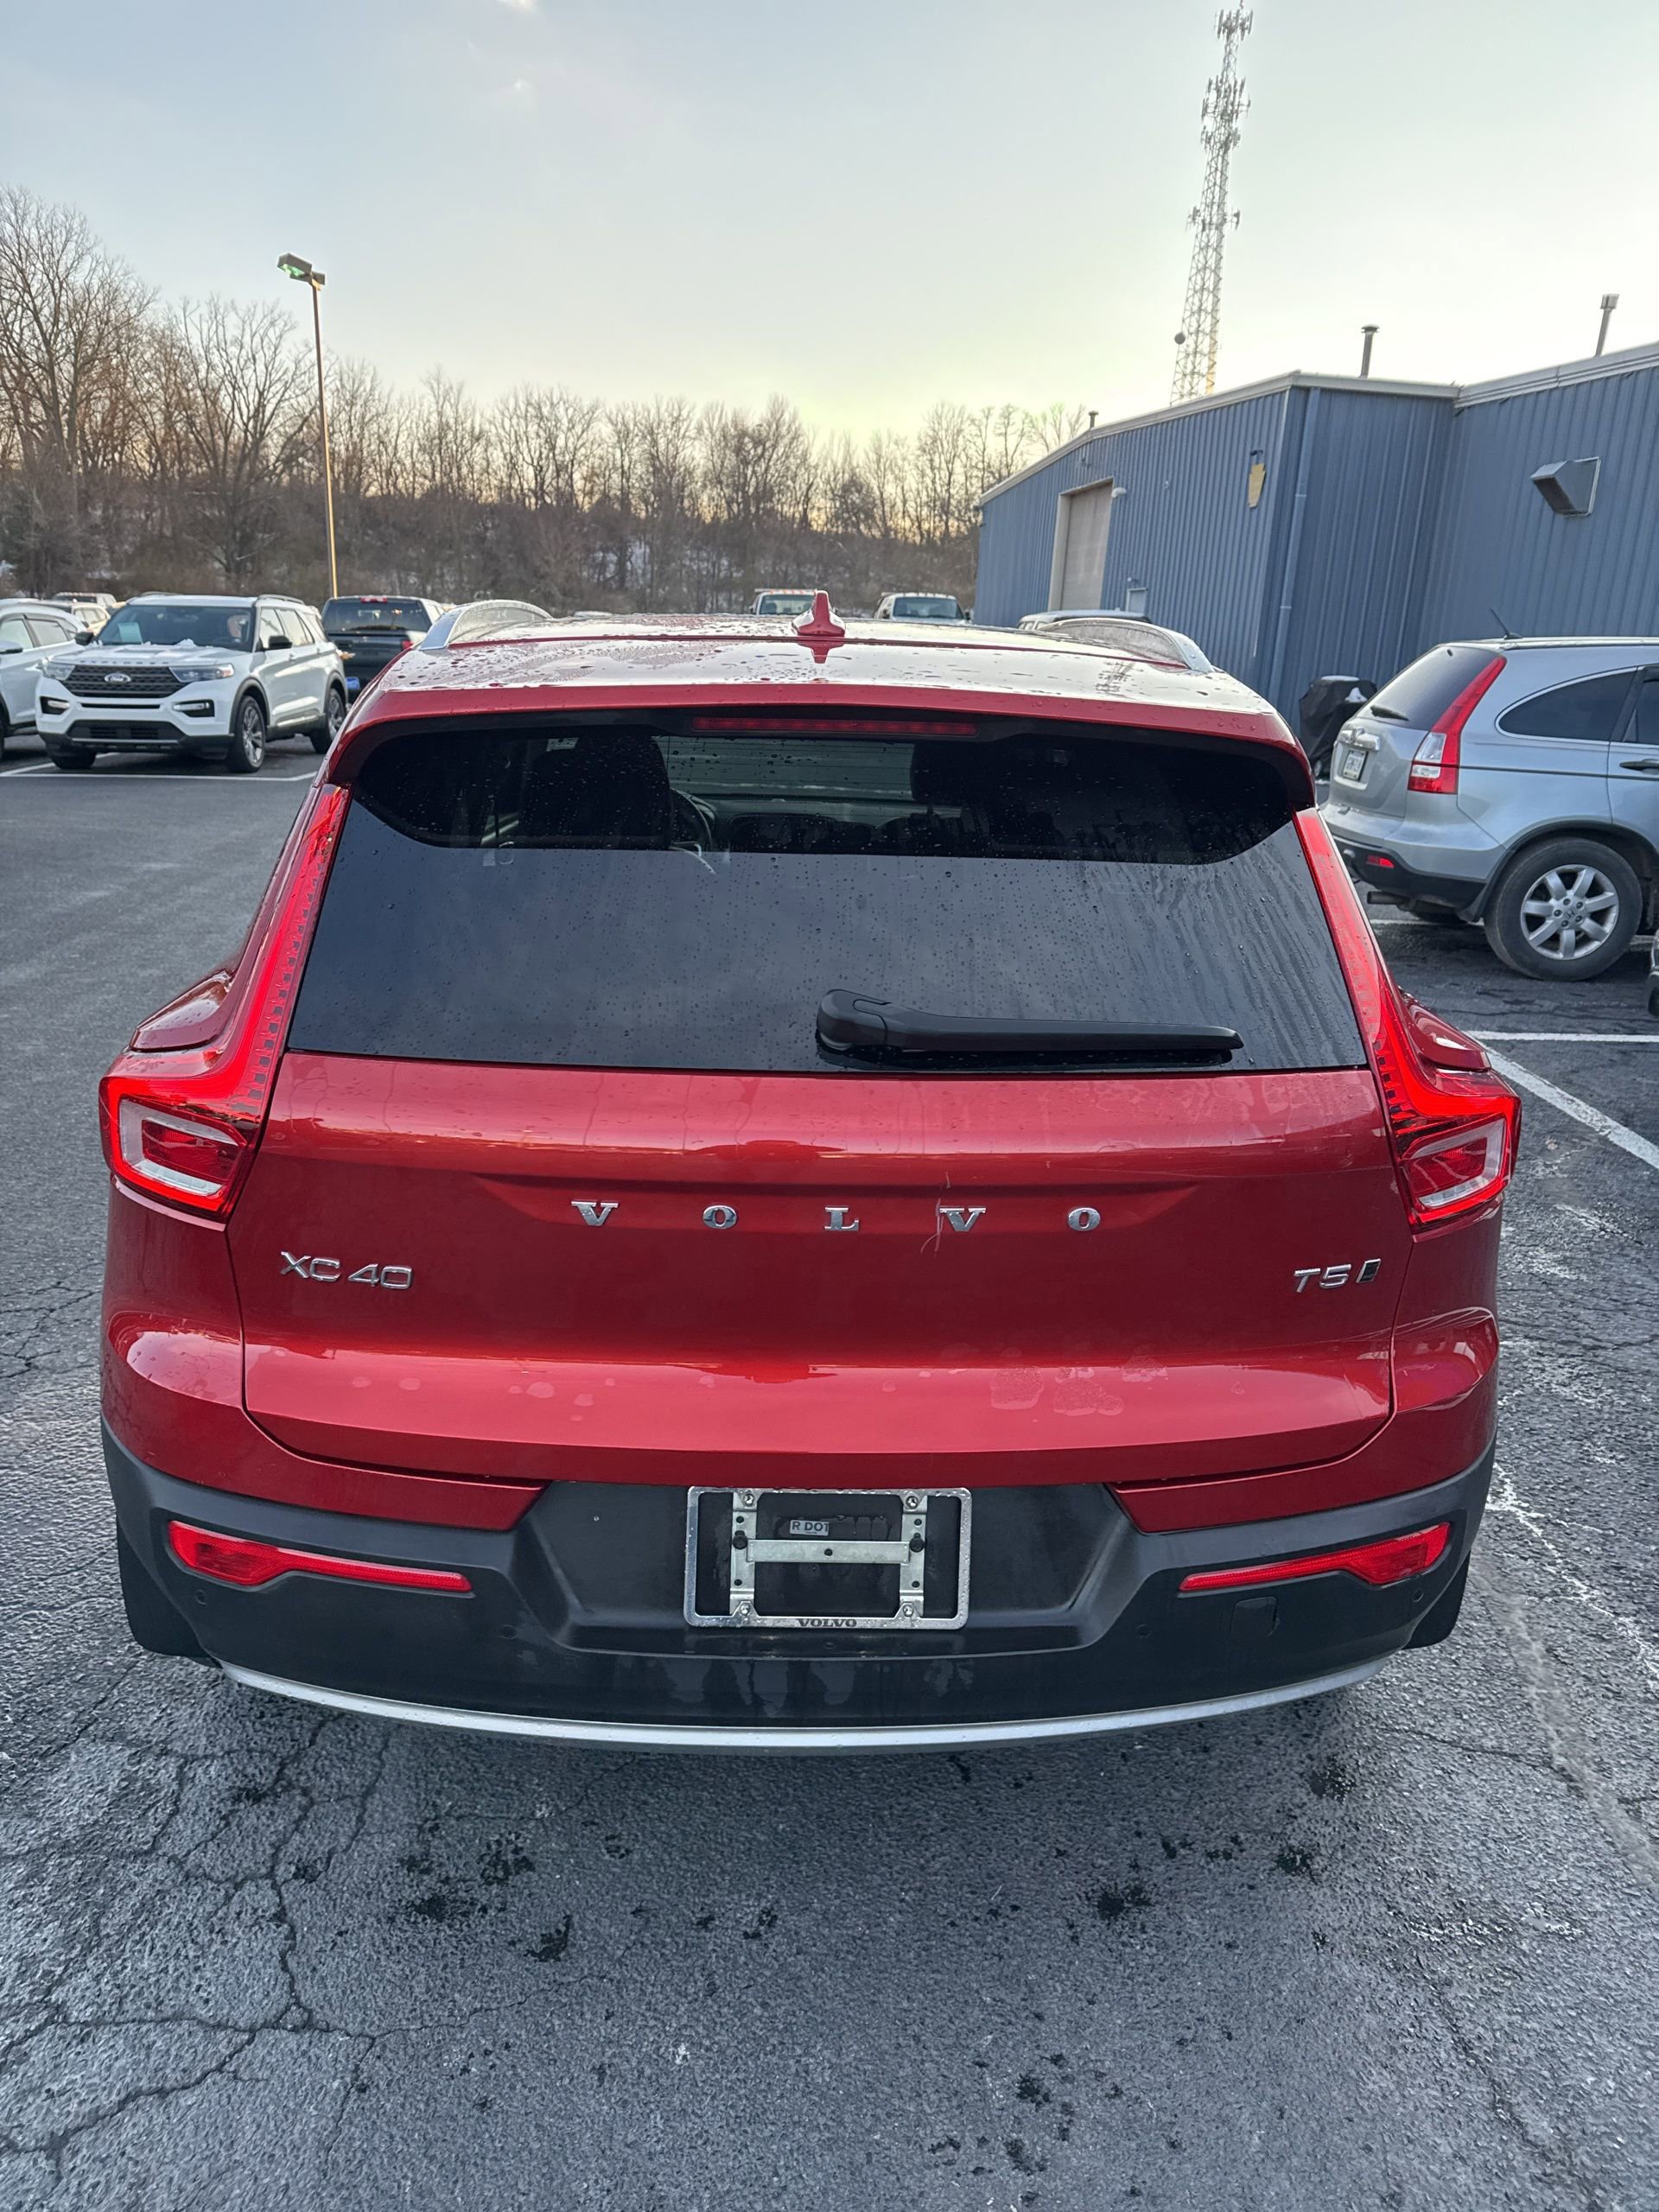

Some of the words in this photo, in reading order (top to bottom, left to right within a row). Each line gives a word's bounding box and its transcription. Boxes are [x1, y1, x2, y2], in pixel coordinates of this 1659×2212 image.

[571, 1200, 1101, 1232] VOLVO
[1294, 1263, 1352, 1293] T5
[791, 1521, 801, 1530] R
[796, 1618, 857, 1628] VOLVO
